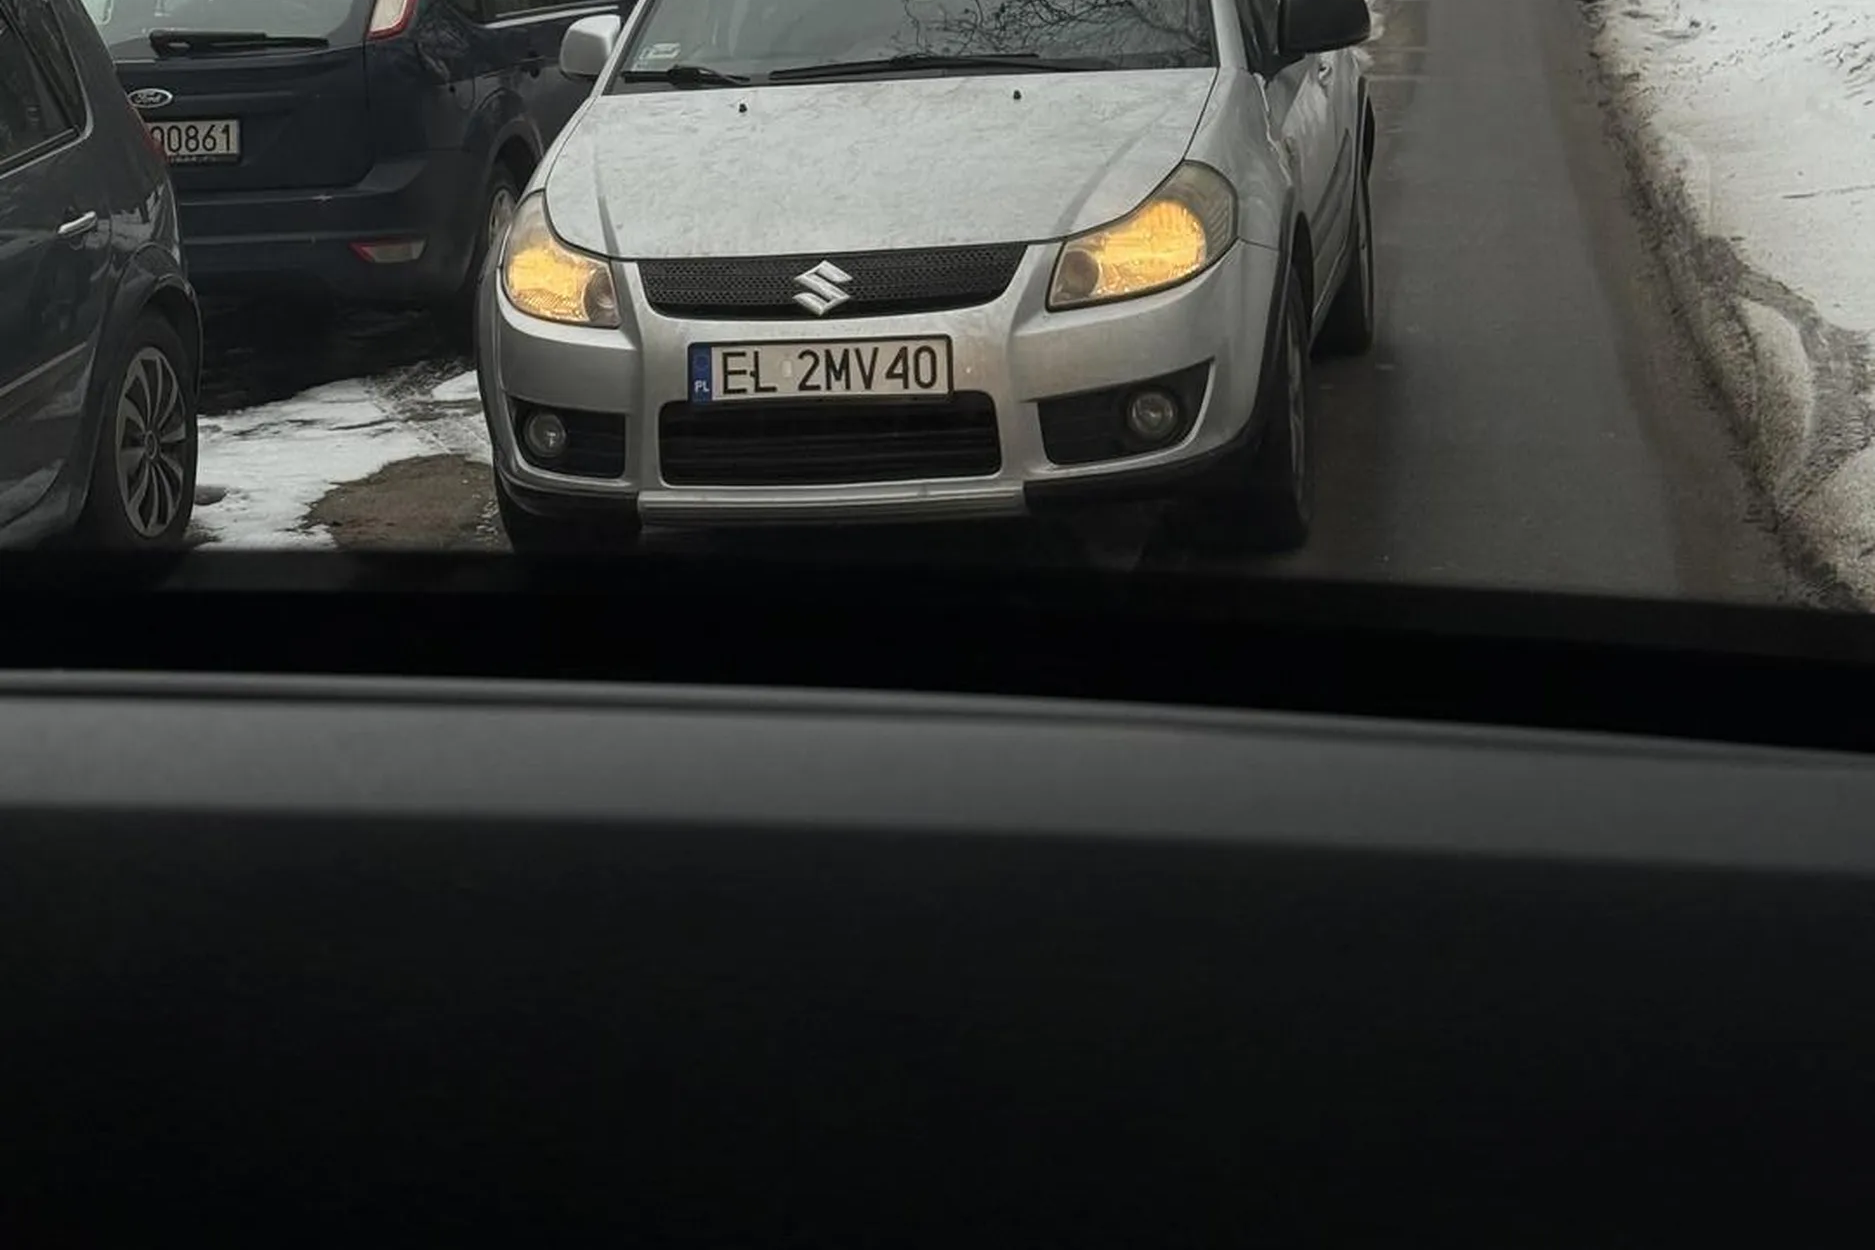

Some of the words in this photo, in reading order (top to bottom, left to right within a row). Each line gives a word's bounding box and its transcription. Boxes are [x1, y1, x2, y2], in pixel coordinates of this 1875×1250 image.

[722, 351, 778, 395] EL
[797, 345, 938, 392] 2MV40
[694, 380, 710, 392] PL
